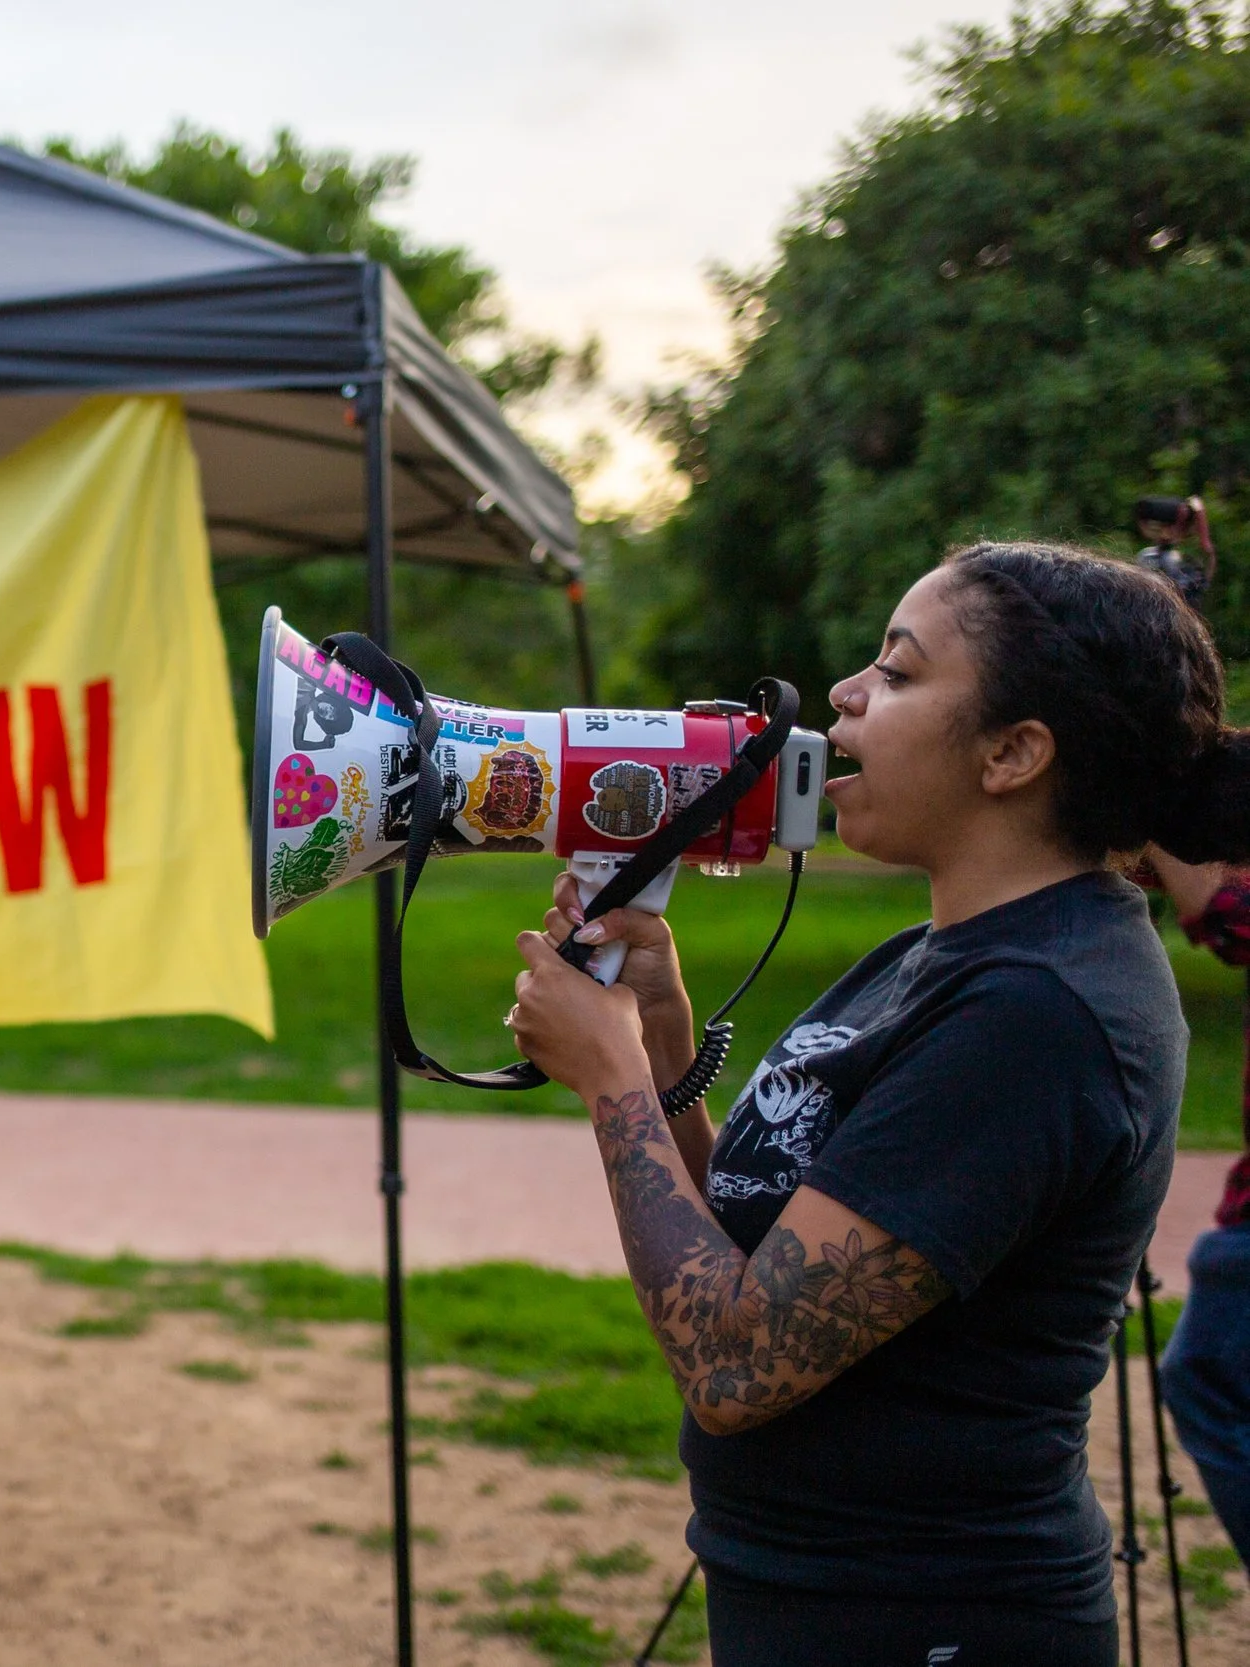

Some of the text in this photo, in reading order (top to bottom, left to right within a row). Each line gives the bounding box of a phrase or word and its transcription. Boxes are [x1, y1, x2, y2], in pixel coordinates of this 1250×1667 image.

[279, 635, 374, 707] ACAB
[375, 746, 389, 843] DESTROY ALL POLICE
[647, 783, 657, 817] WOMAN
[620, 810, 629, 833] GIFTED
[269, 860, 285, 903] POWER
